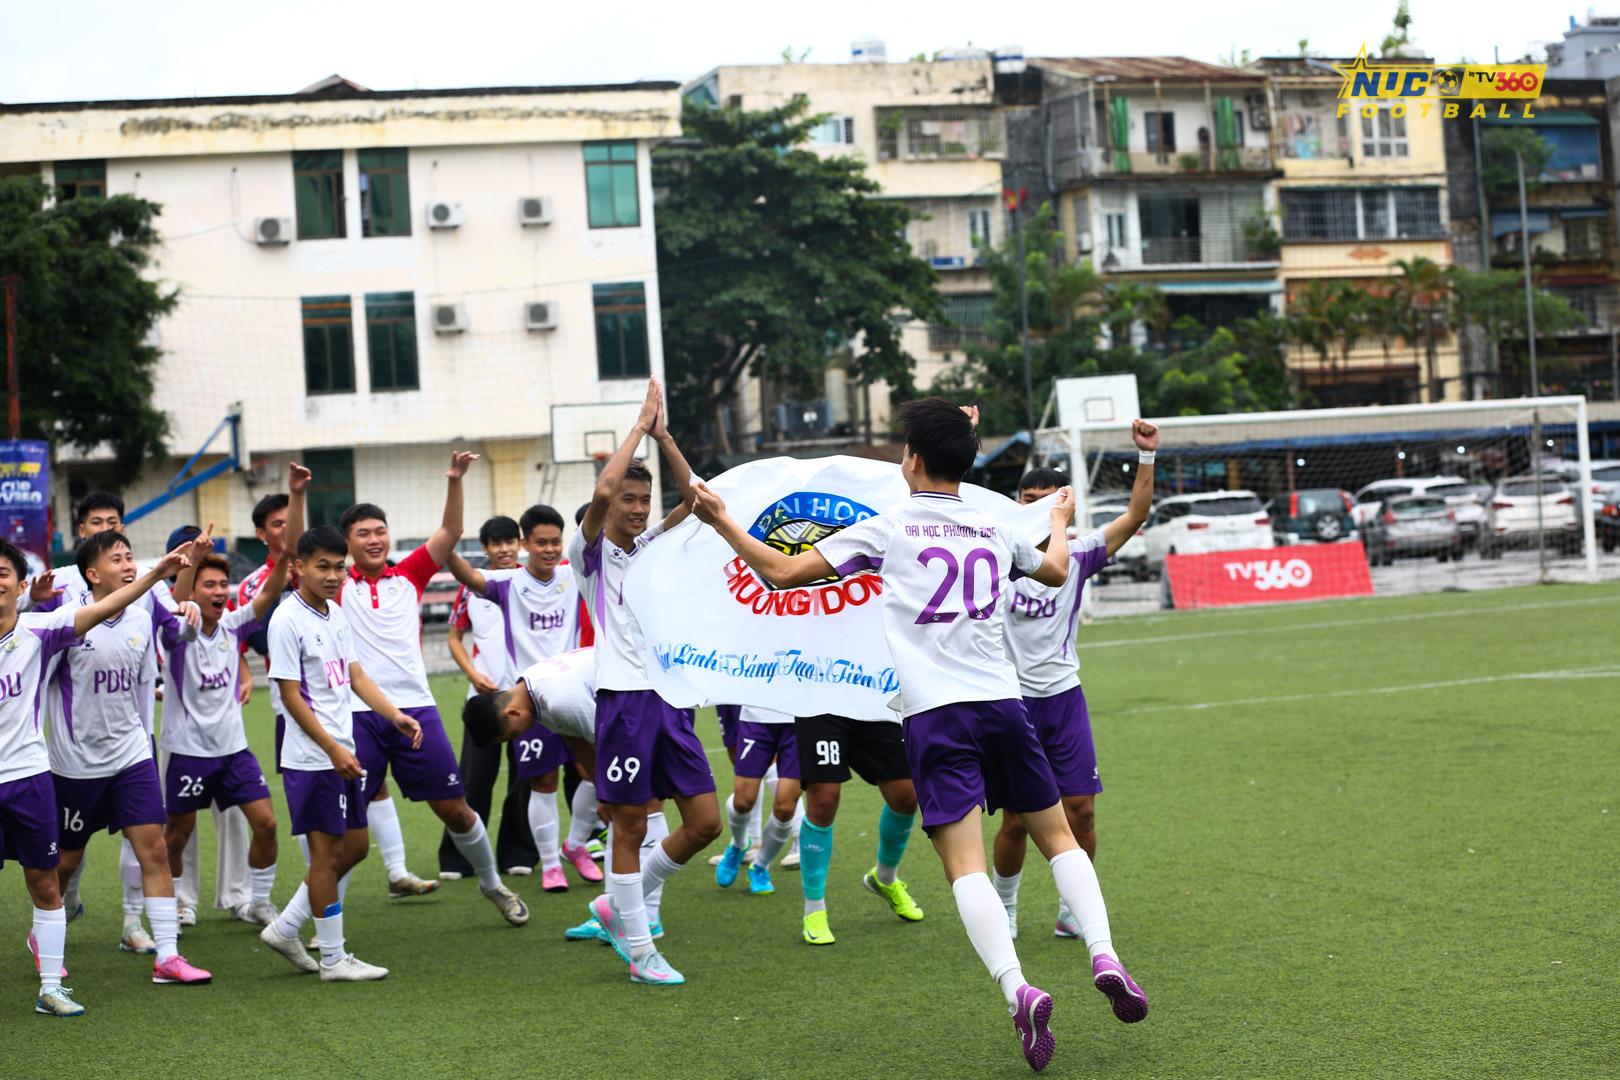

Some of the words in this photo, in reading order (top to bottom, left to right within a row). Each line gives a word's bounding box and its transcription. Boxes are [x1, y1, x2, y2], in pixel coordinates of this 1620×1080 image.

[914, 546, 1001, 625] 20
[1223, 558, 1313, 590] TV360
[1010, 590, 1058, 618] PDU
[529, 608, 566, 631] PDU
[94, 667, 133, 694] PDU
[519, 738, 543, 762] 29
[740, 737, 756, 760] 7
[816, 740, 840, 765] 98
[606, 755, 641, 783] 69
[177, 774, 204, 798] 26
[63, 806, 84, 832] 16
